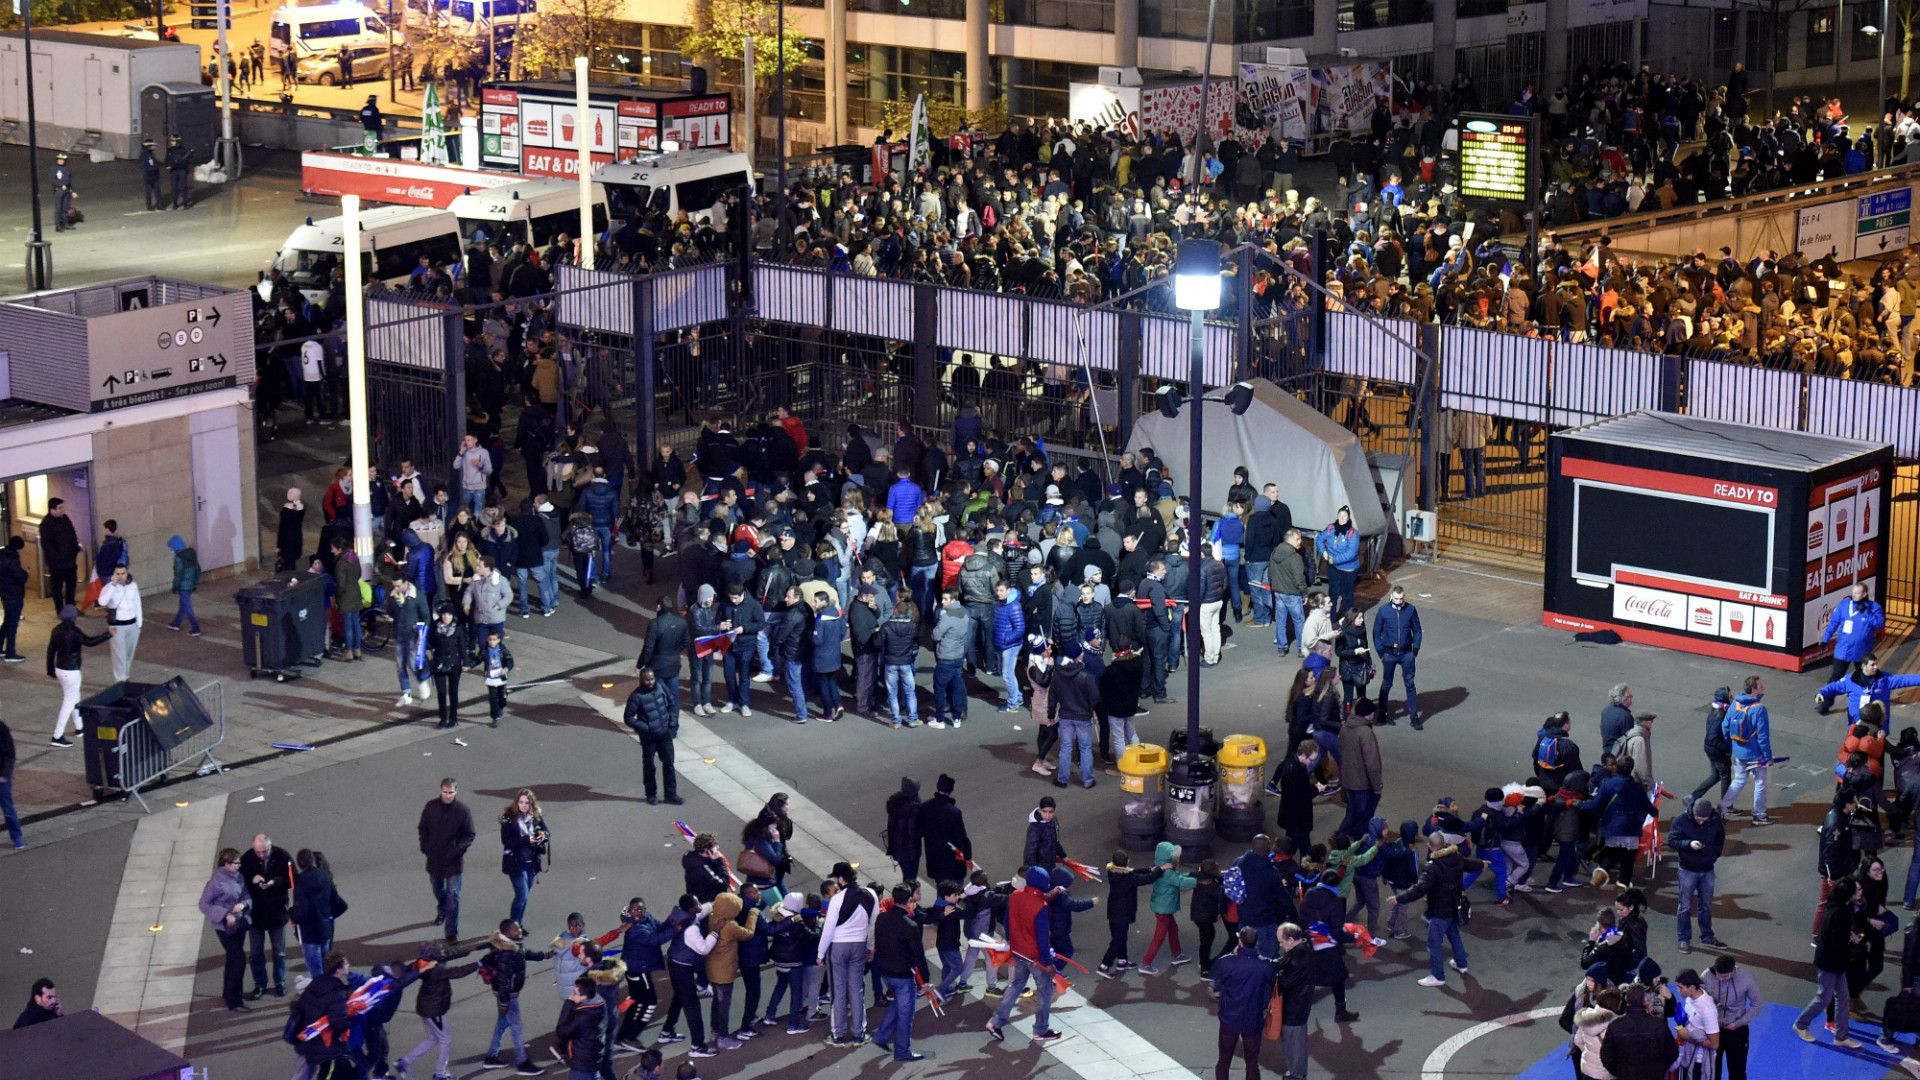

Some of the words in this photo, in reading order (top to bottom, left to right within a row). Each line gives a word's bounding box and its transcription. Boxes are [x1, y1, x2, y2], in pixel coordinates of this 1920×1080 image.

[689, 102, 714, 113] READY
[715, 100, 726, 110] TO
[528, 155, 551, 171] EAT
[552, 157, 561, 173] &
[564, 158, 606, 177] DRNK
[631, 172, 649, 180] 2C
[489, 205, 506, 214] 2A
[128, 391, 160, 405] bientôt
[176, 387, 188, 396] See
[189, 385, 204, 396] you
[205, 381, 226, 391] soon!
[1713, 483, 1754, 500] READY
[1757, 490, 1774, 503] TO
[1738, 591, 1752, 601] EAT
